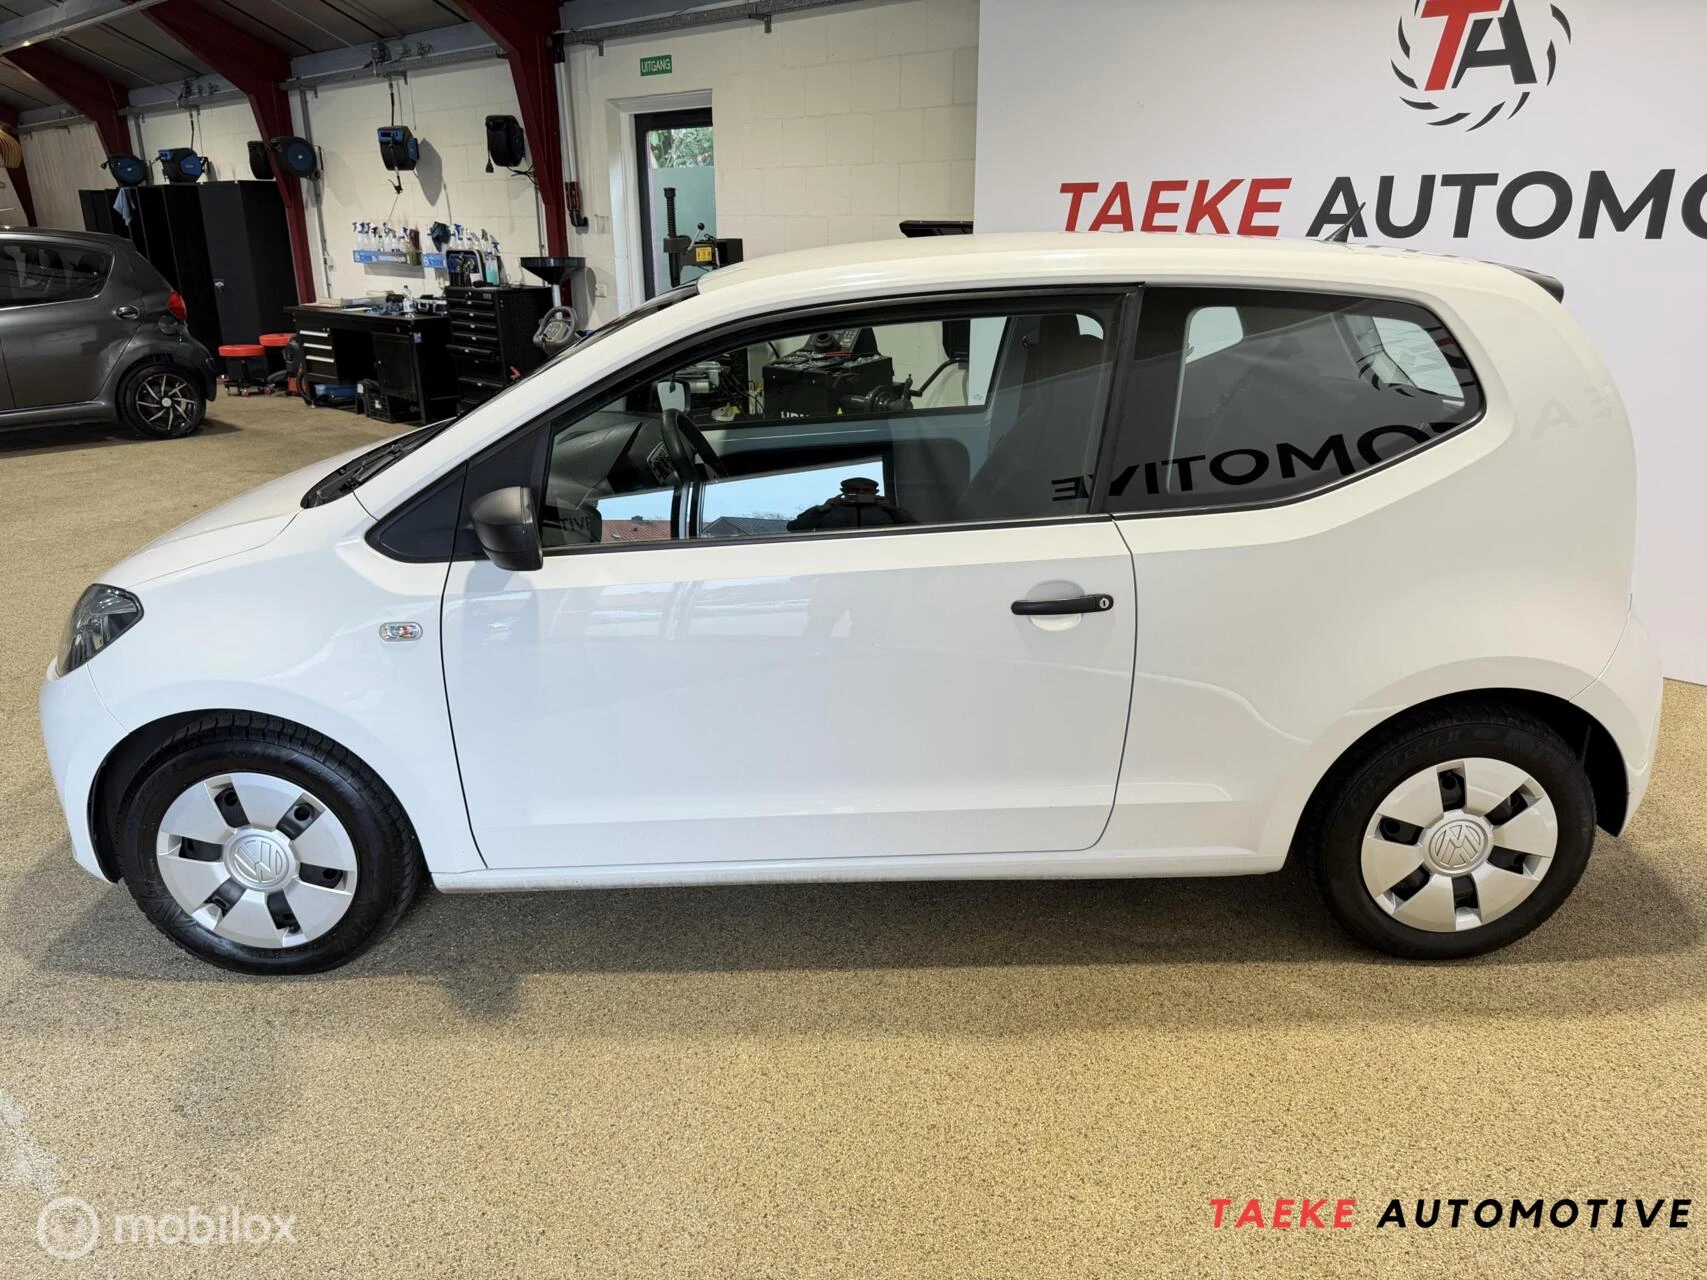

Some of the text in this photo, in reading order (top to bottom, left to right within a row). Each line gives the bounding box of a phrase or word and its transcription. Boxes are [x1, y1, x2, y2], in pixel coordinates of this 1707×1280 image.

[641, 58, 671, 73] UITGANG
[1421, 0, 1537, 91] TA
[1060, 177, 1293, 237] TAEKE
